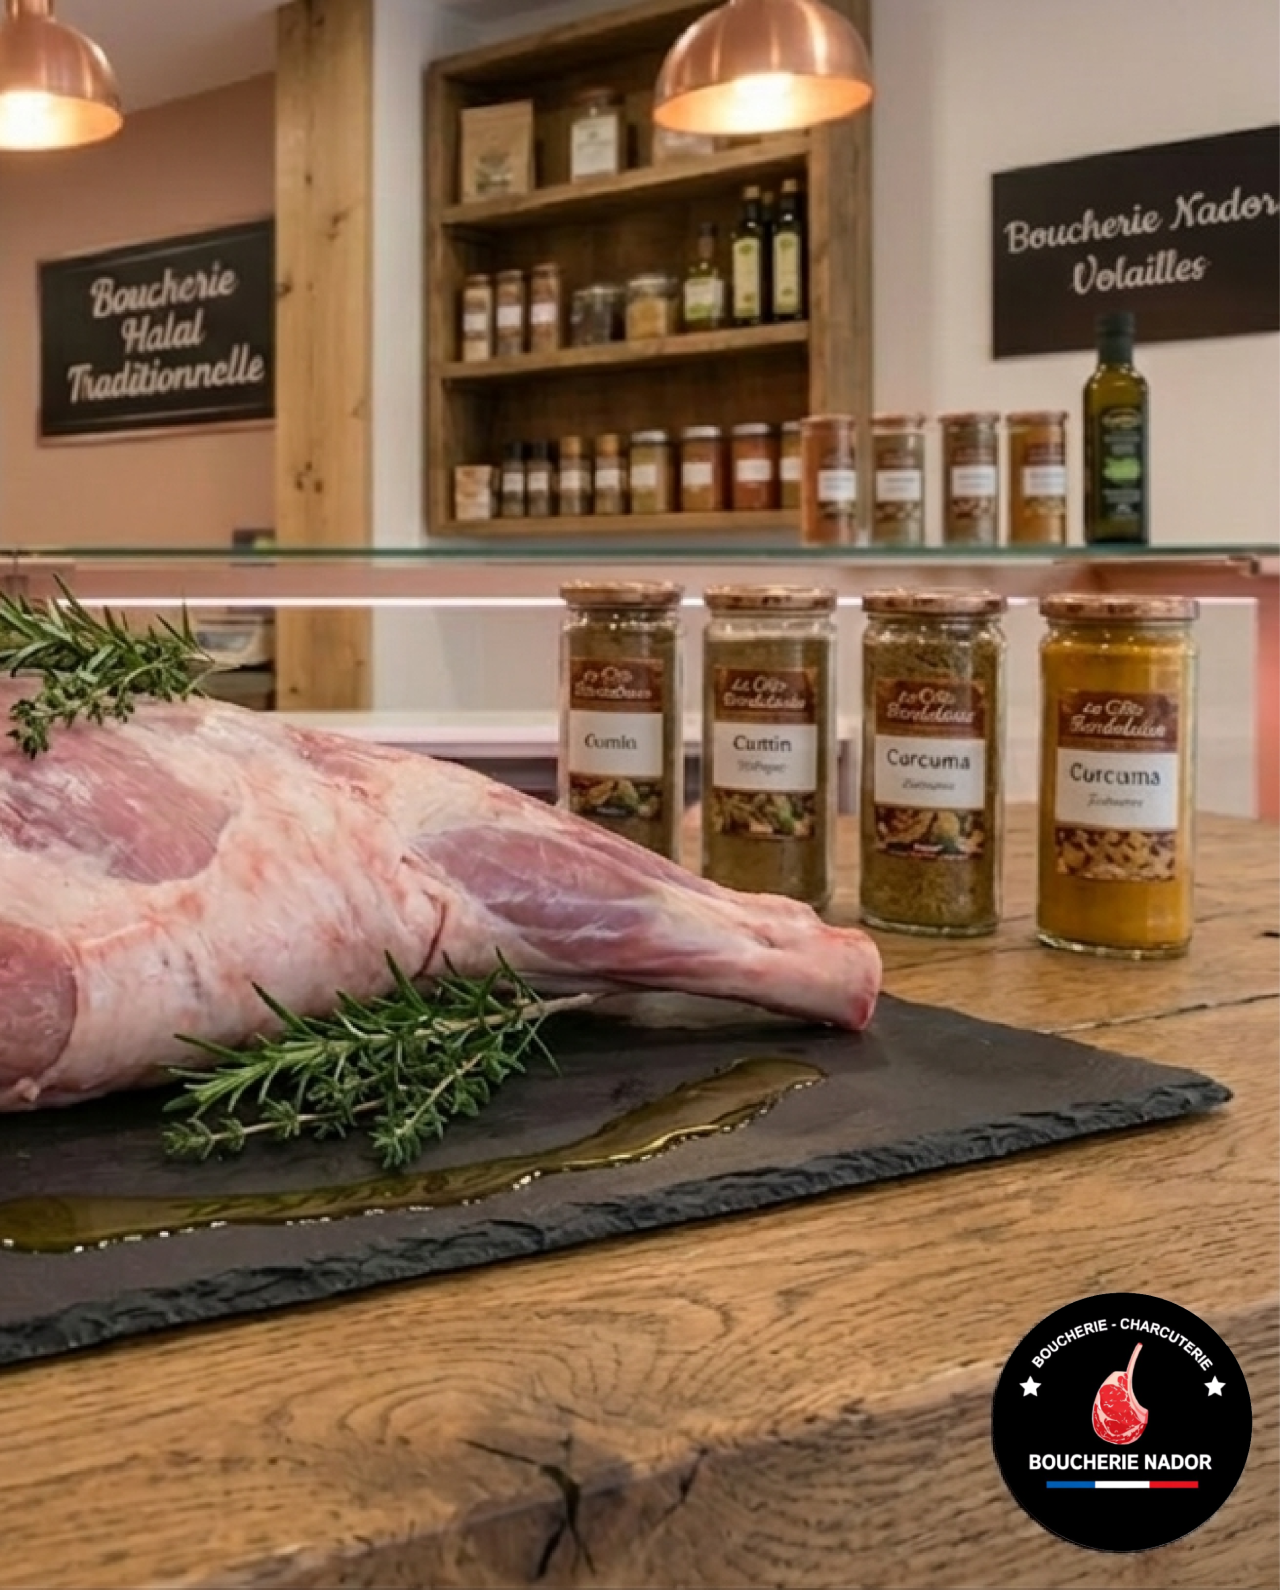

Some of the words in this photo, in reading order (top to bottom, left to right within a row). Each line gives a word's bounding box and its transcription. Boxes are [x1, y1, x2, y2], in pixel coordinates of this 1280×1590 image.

[1003, 204, 1163, 254] Boucherie
[1170, 186, 1280, 231] Nador
[90, 260, 238, 318] Boucherie
[1070, 249, 1211, 295] Volailles
[121, 307, 205, 354] Halal
[67, 343, 265, 404] Traditionnelle
